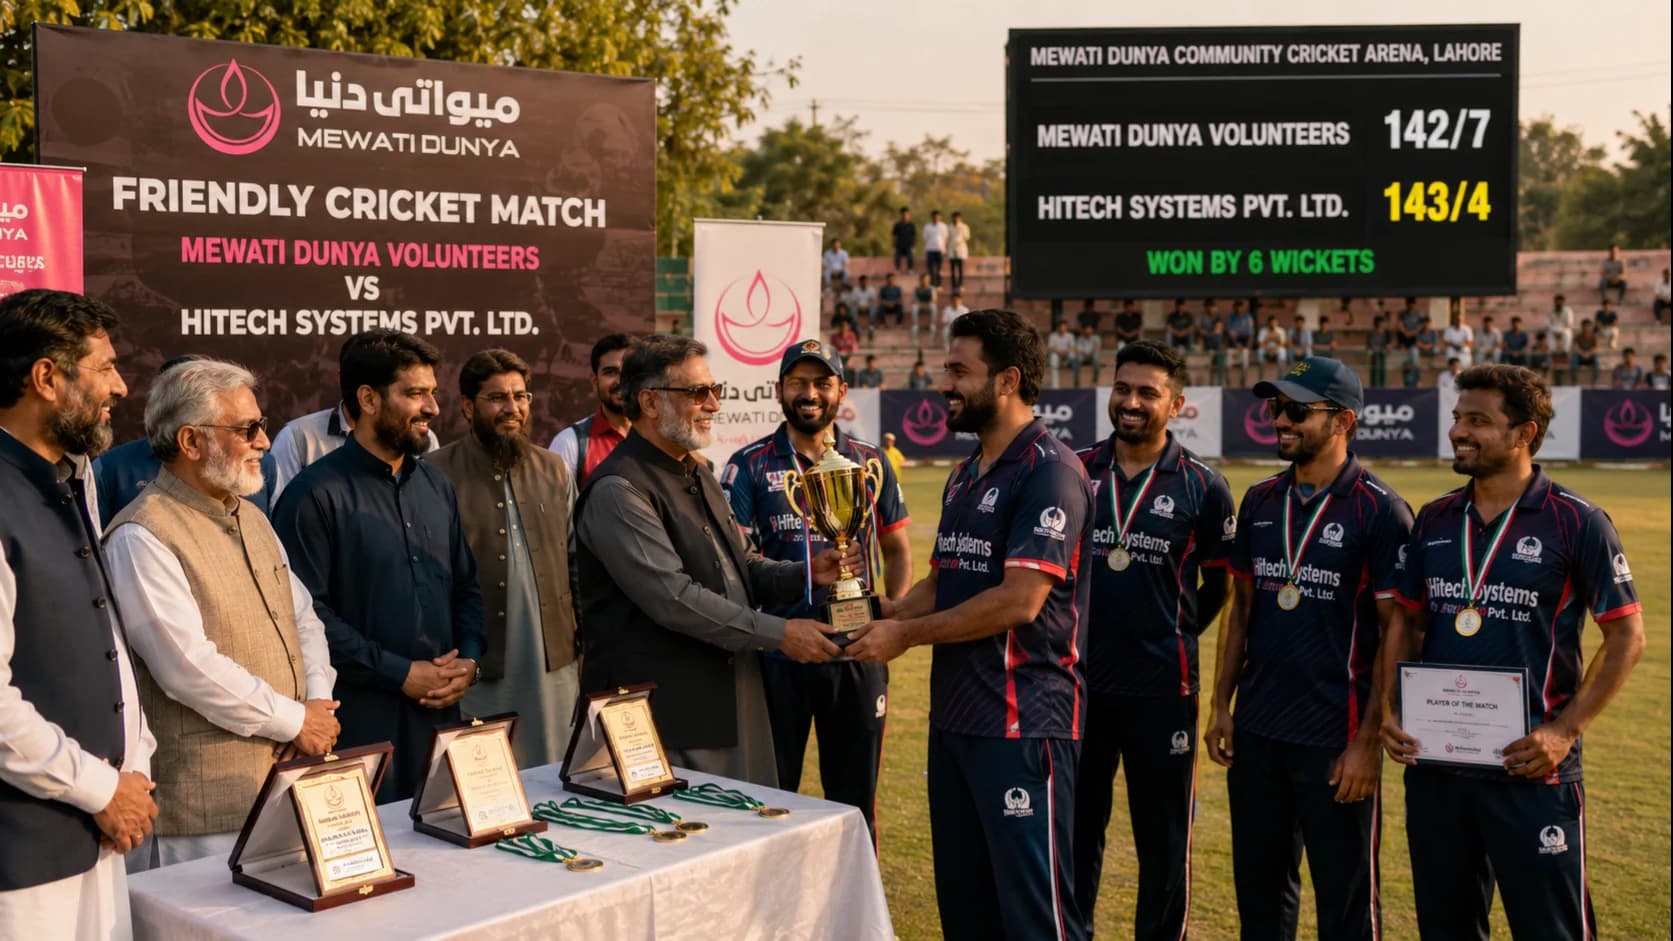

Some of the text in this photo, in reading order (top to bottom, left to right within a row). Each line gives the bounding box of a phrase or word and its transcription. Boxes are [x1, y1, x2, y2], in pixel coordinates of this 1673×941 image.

[1030, 42, 1502, 65] MEWATI DUNYA COMMUNITY CRICKET ARENA, LAHORE
[296, 69, 521, 129] میواتی دنیا
[297, 127, 521, 159] MEWATI DUNYA
[1037, 107, 1492, 151] MEWATI DUNYA VOLUNTEERS 142/7
[112, 176, 607, 229] FRIENDLY CRICKET MATCH
[1038, 179, 1493, 223] HITECH SYSTEMS PVT. LTD. 143/4
[180, 235, 541, 271] MEWATI DUNYA VOLUNTEERS
[1146, 248, 1376, 275] WON BY 6 WICKETS
[344, 275, 380, 301] VS
[181, 308, 288, 336] HITECH
[424, 310, 481, 336] PVT.
[487, 311, 540, 336] LTD.
[777, 513, 802, 531] Hite
[1092, 525, 1115, 544] ech
[1123, 530, 1172, 554] ystems
[1294, 562, 1342, 587] ystems
[1487, 606, 1509, 620] Pvt.
[1511, 608, 1532, 623] Ltd.
